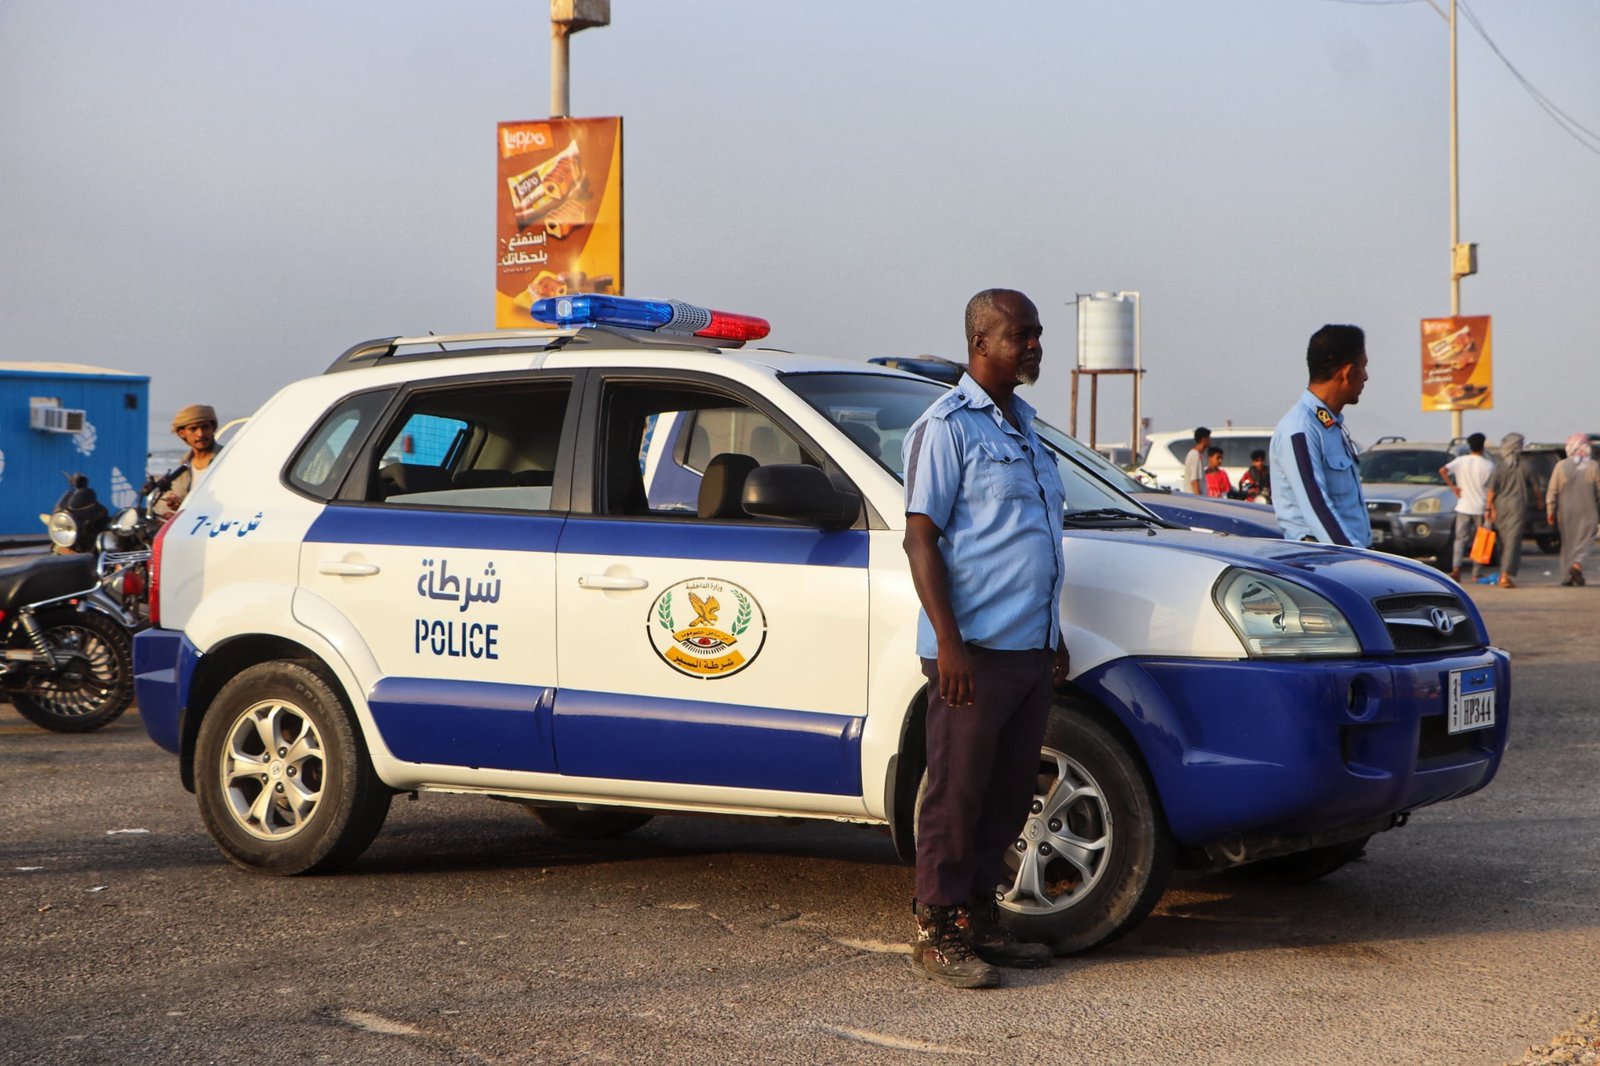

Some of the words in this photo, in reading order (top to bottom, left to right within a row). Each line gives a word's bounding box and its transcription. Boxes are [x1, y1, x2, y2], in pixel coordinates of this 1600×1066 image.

[417, 558, 502, 613] شرطة
[415, 618, 499, 660] POLICE
[673, 656, 701, 668] السير
[704, 658, 734, 670] شرطة
